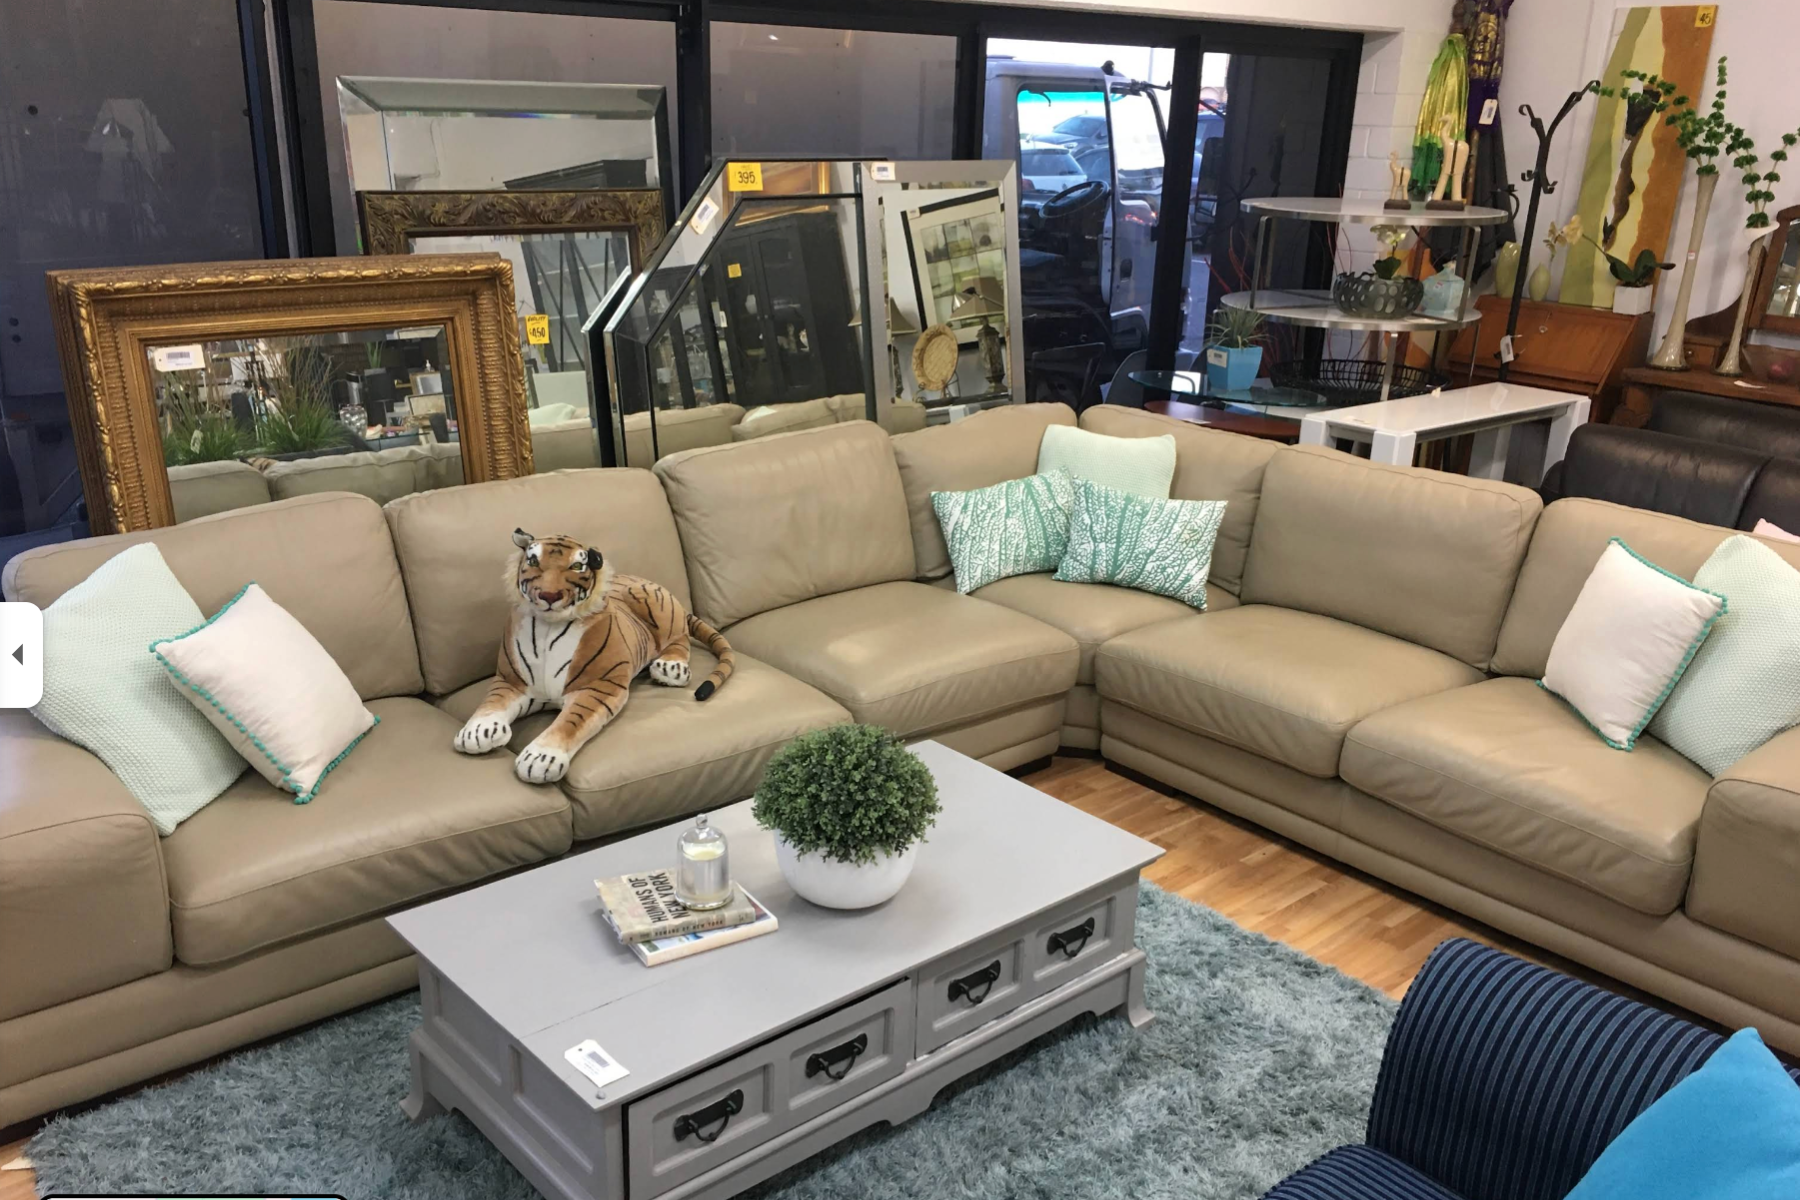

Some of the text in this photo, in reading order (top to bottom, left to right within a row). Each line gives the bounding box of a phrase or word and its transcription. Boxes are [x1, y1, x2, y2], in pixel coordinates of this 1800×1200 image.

[1700, 12, 1711, 25] 45
[737, 171, 756, 184] 395
[628, 877, 669, 924] HUMANS OF
[648, 872, 691, 919] NEW YORK
